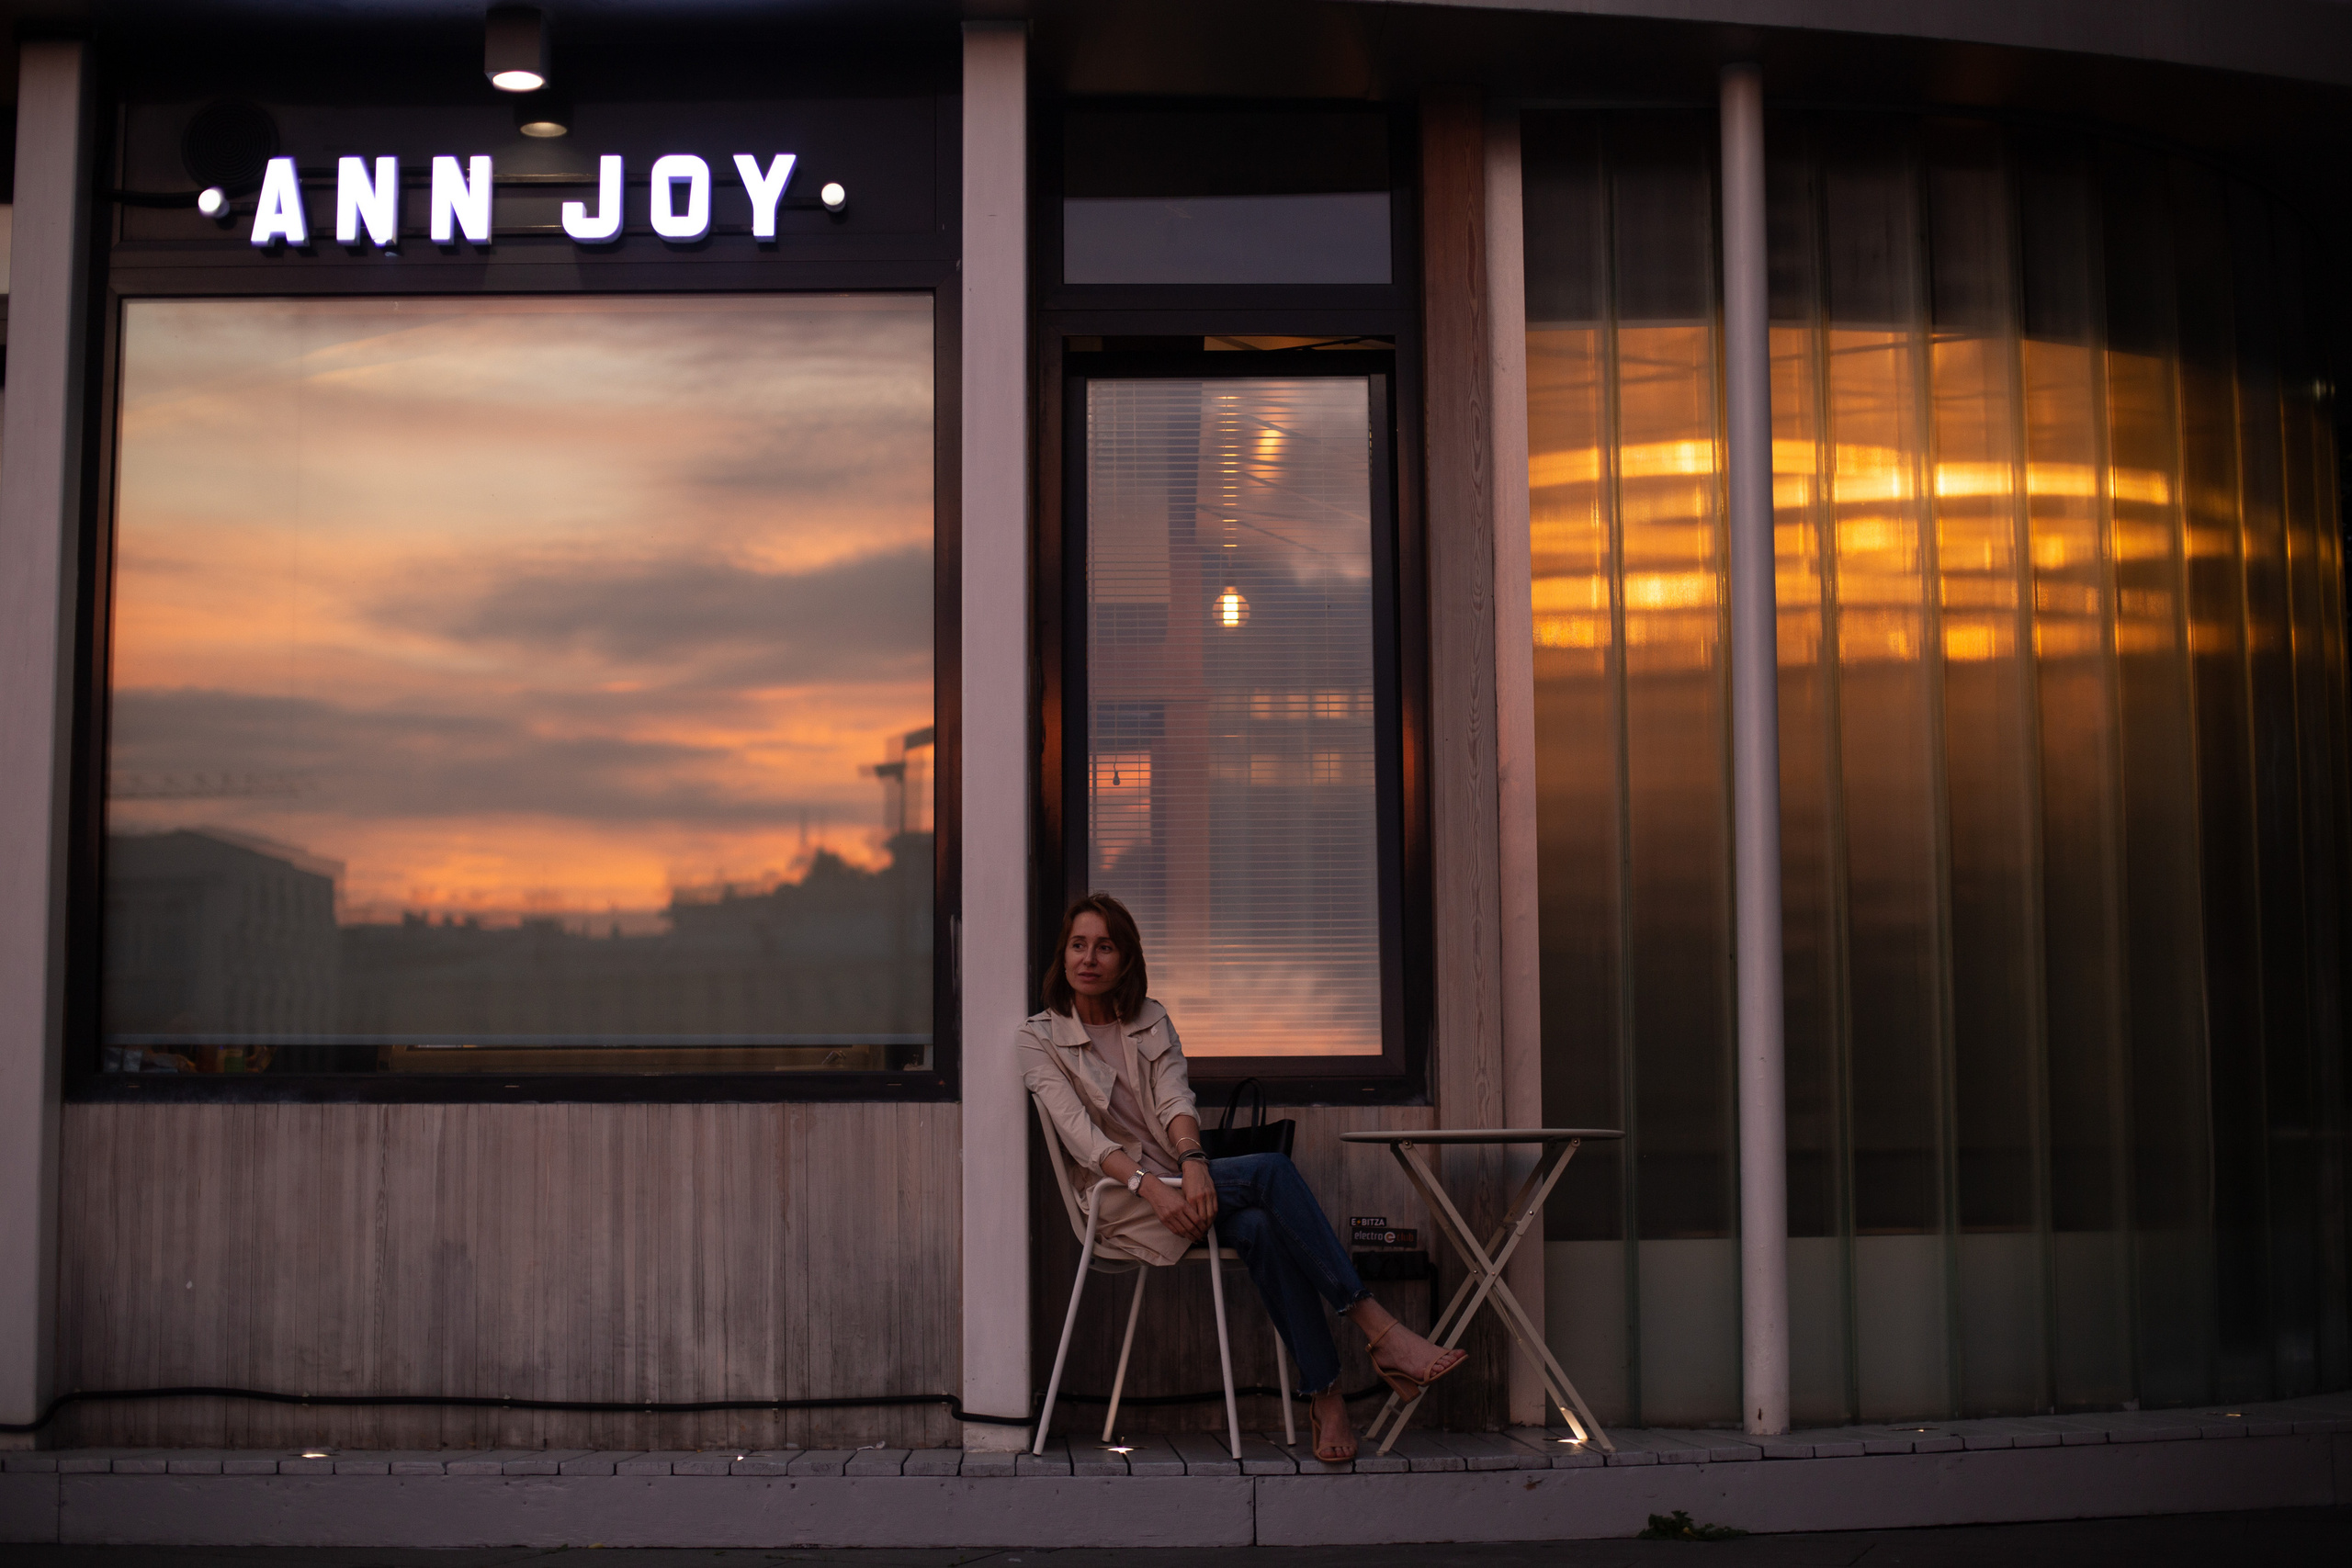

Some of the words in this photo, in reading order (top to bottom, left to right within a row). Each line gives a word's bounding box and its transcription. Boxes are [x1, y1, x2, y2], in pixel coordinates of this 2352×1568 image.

[250, 155, 492, 247] ANN
[561, 153, 797, 243] JOY
[1353, 1230, 1384, 1241] electro
